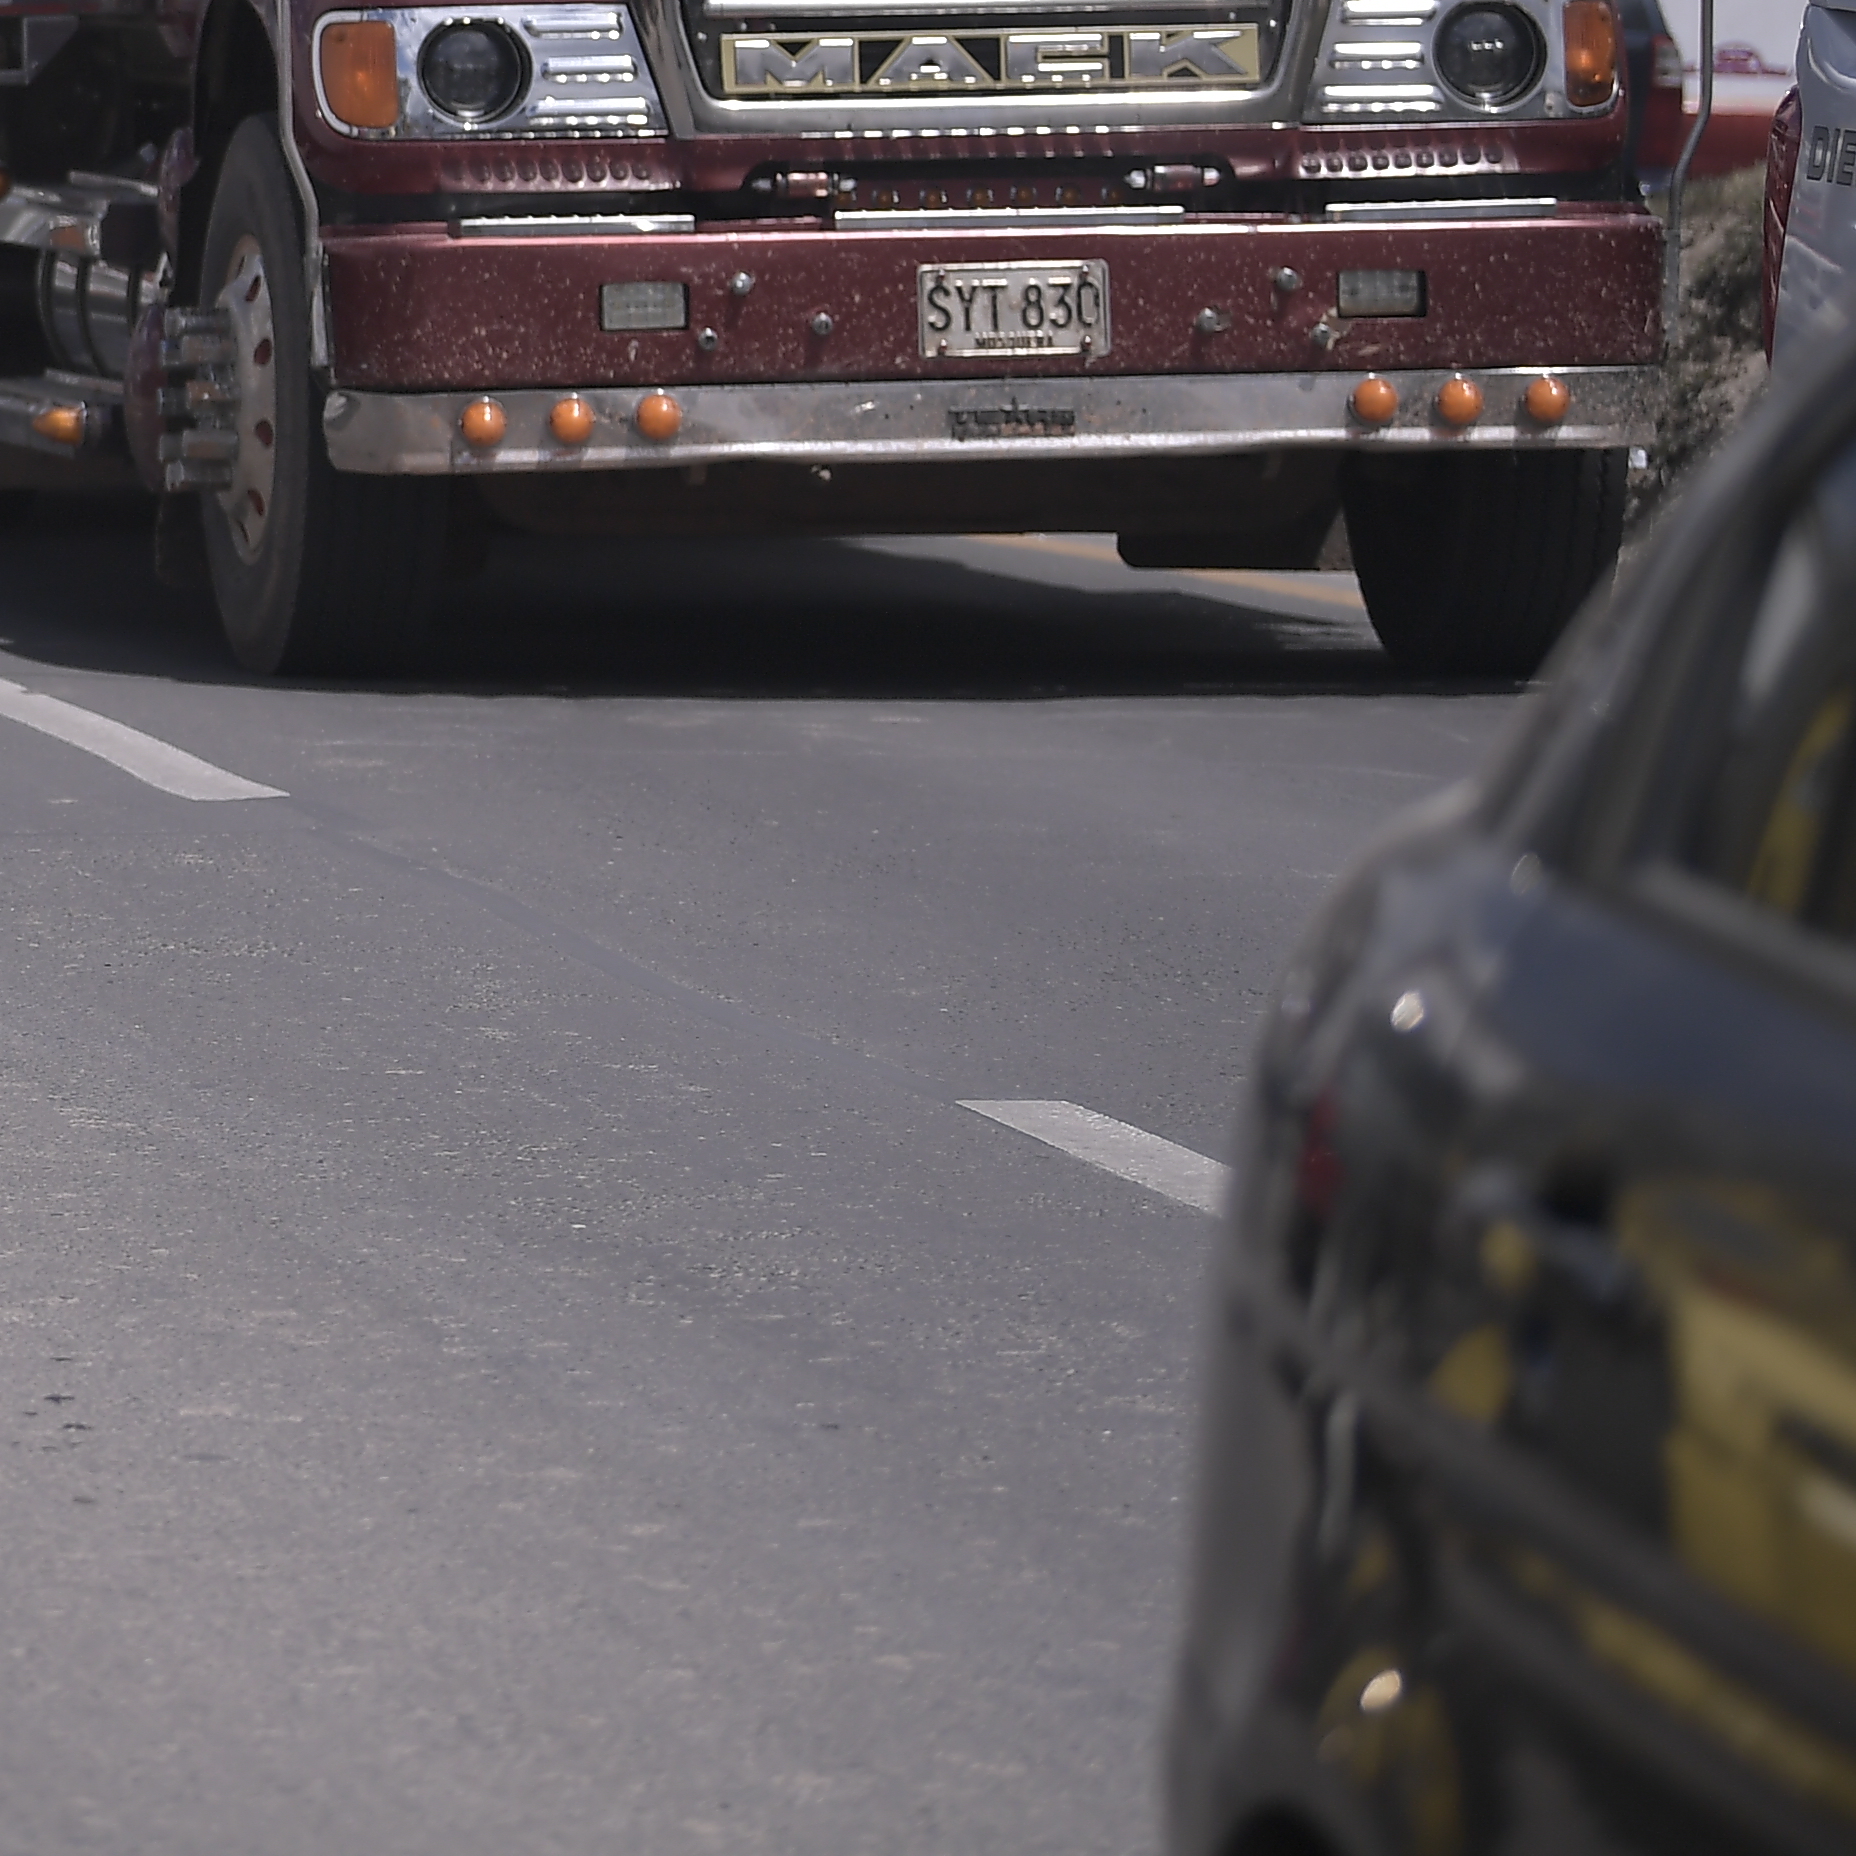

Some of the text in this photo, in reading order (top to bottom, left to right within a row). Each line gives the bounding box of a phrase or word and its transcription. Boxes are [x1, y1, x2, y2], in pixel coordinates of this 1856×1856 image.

[728, 28, 1254, 91] MACK
[927, 277, 1100, 332] SYT 830
